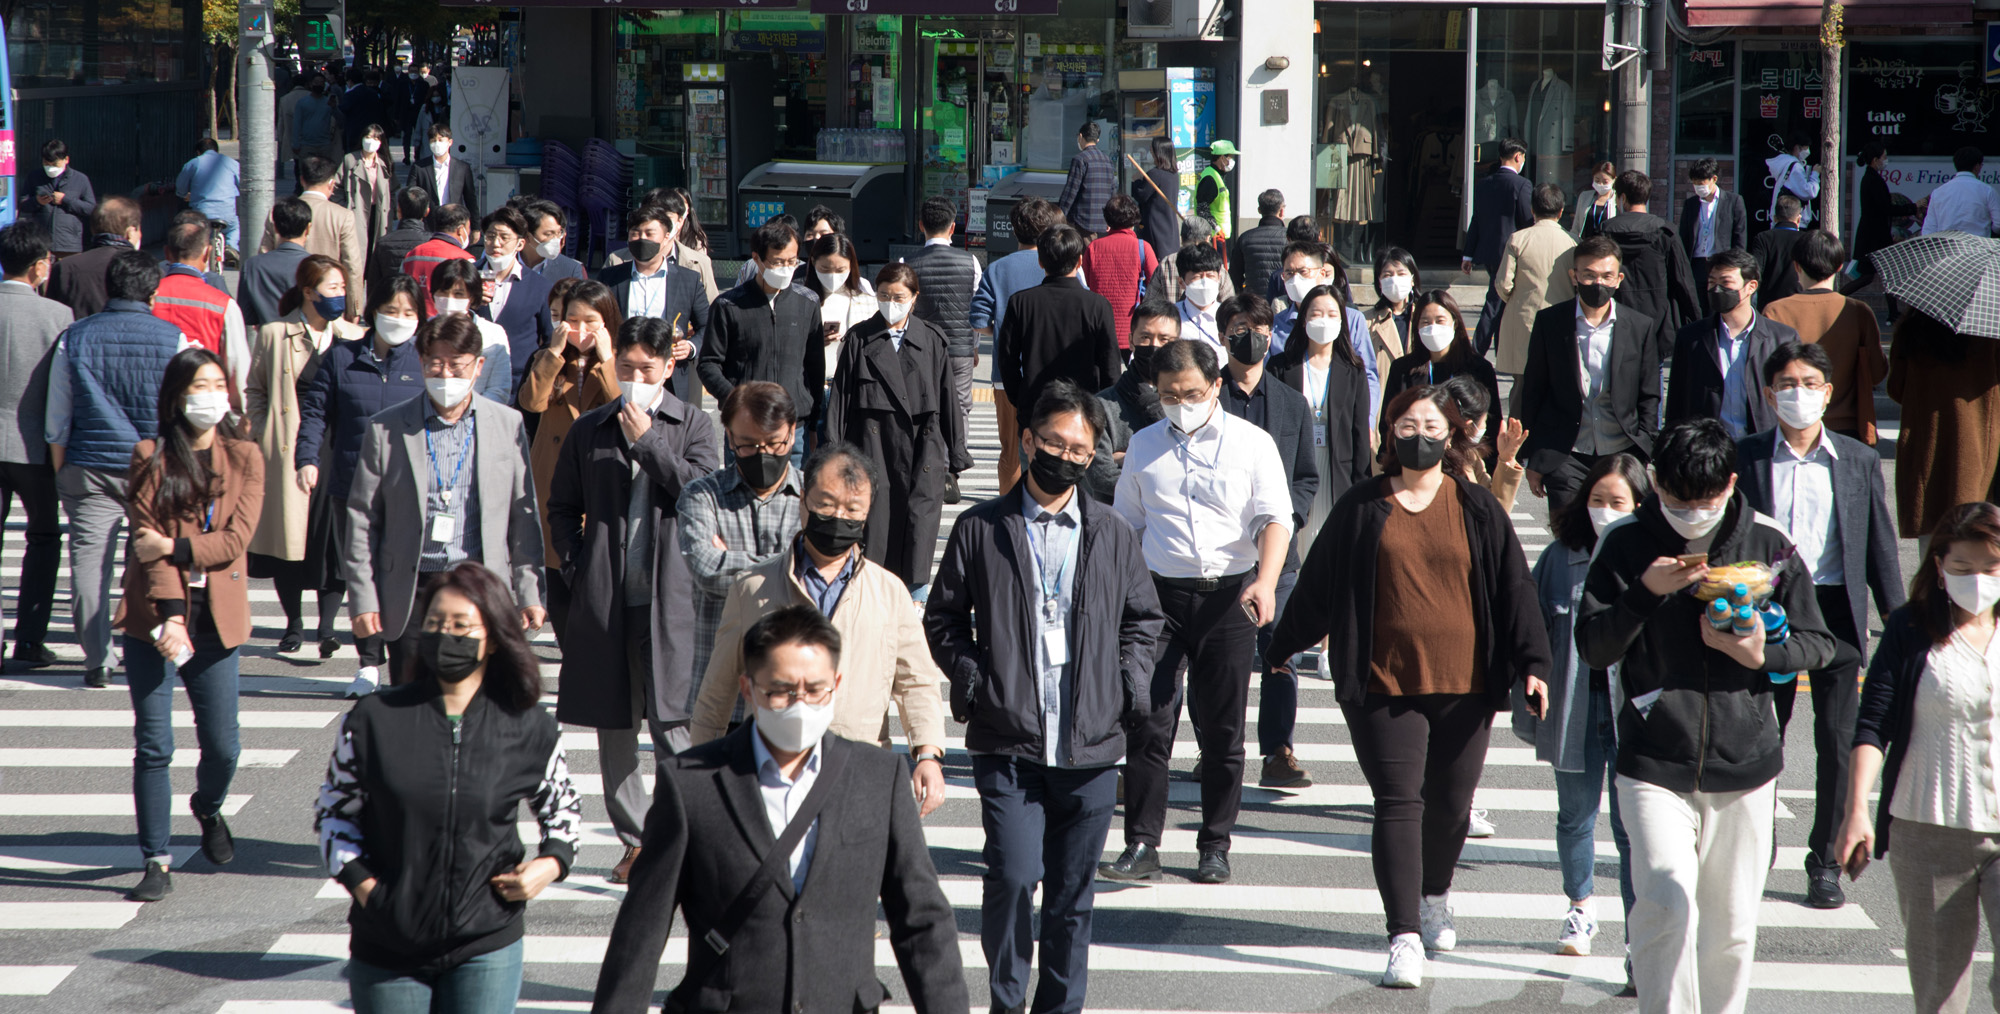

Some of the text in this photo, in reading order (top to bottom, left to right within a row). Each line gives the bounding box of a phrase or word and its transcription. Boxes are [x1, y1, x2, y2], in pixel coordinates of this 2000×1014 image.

[307, 20, 337, 50] 36
[757, 32, 798, 47] 재난지원금
[1867, 110, 1906, 122] take
[1872, 124, 1901, 135] out
[1880, 169, 1902, 185] BQ
[1905, 172, 1915, 182] &
[1916, 169, 1957, 184] Frie
